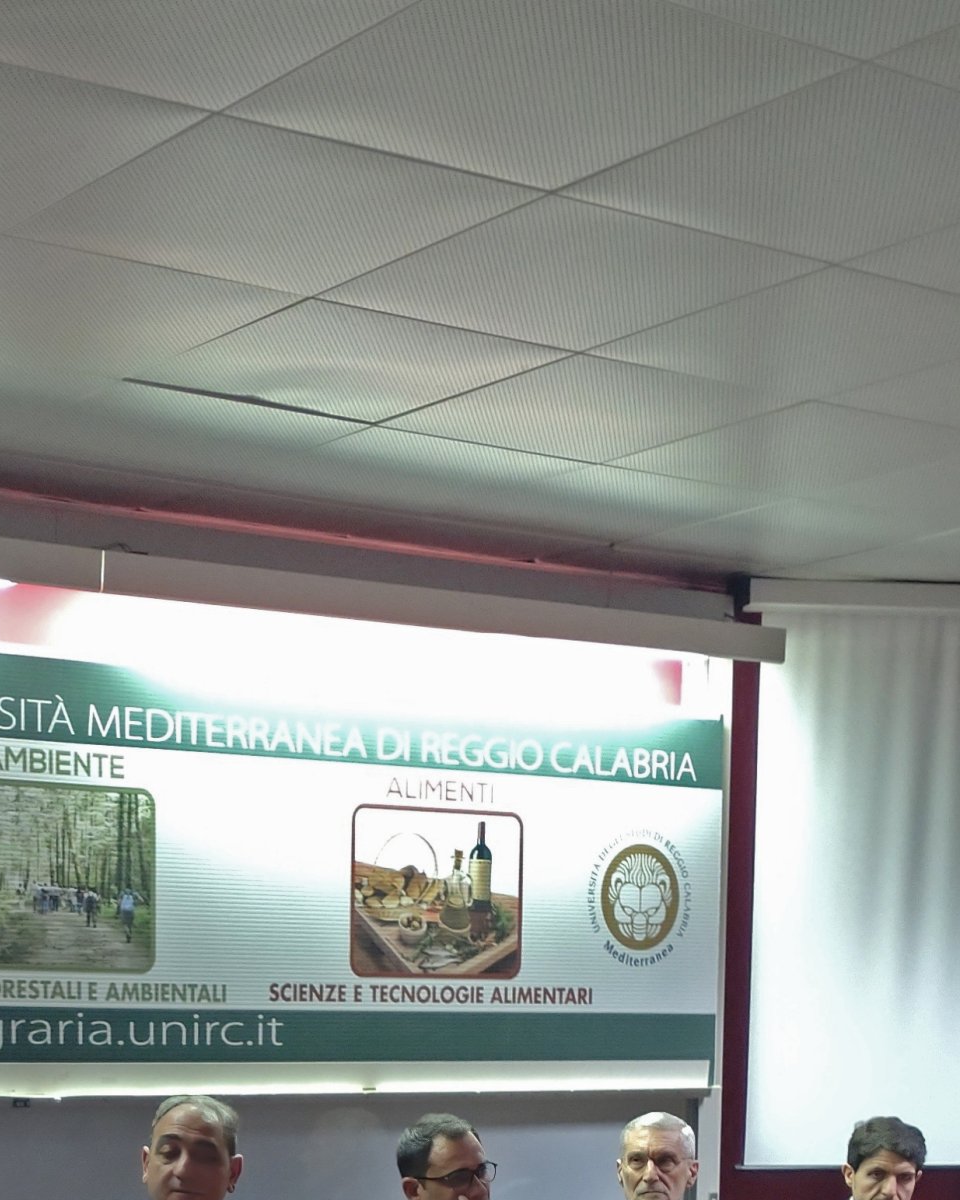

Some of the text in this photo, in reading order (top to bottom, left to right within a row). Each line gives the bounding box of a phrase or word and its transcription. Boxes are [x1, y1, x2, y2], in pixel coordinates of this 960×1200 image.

[87, 703, 368, 760] MEDITERRANEA
[377, 727, 410, 762] DI
[421, 730, 543, 771] REGGIO
[550, 742, 697, 782] CALABRIA
[386, 777, 495, 804] ALIMENTI
[664, 839, 689, 879] REGGIO
[675, 882, 691, 937] CALABRIA
[603, 940, 674, 967] Mediterranea
[88, 981, 97, 1001] E
[105, 981, 227, 1004] AMBIENTALI
[269, 983, 593, 1005] SCIENZE E TECNOLOGIE ALIMENTARI
